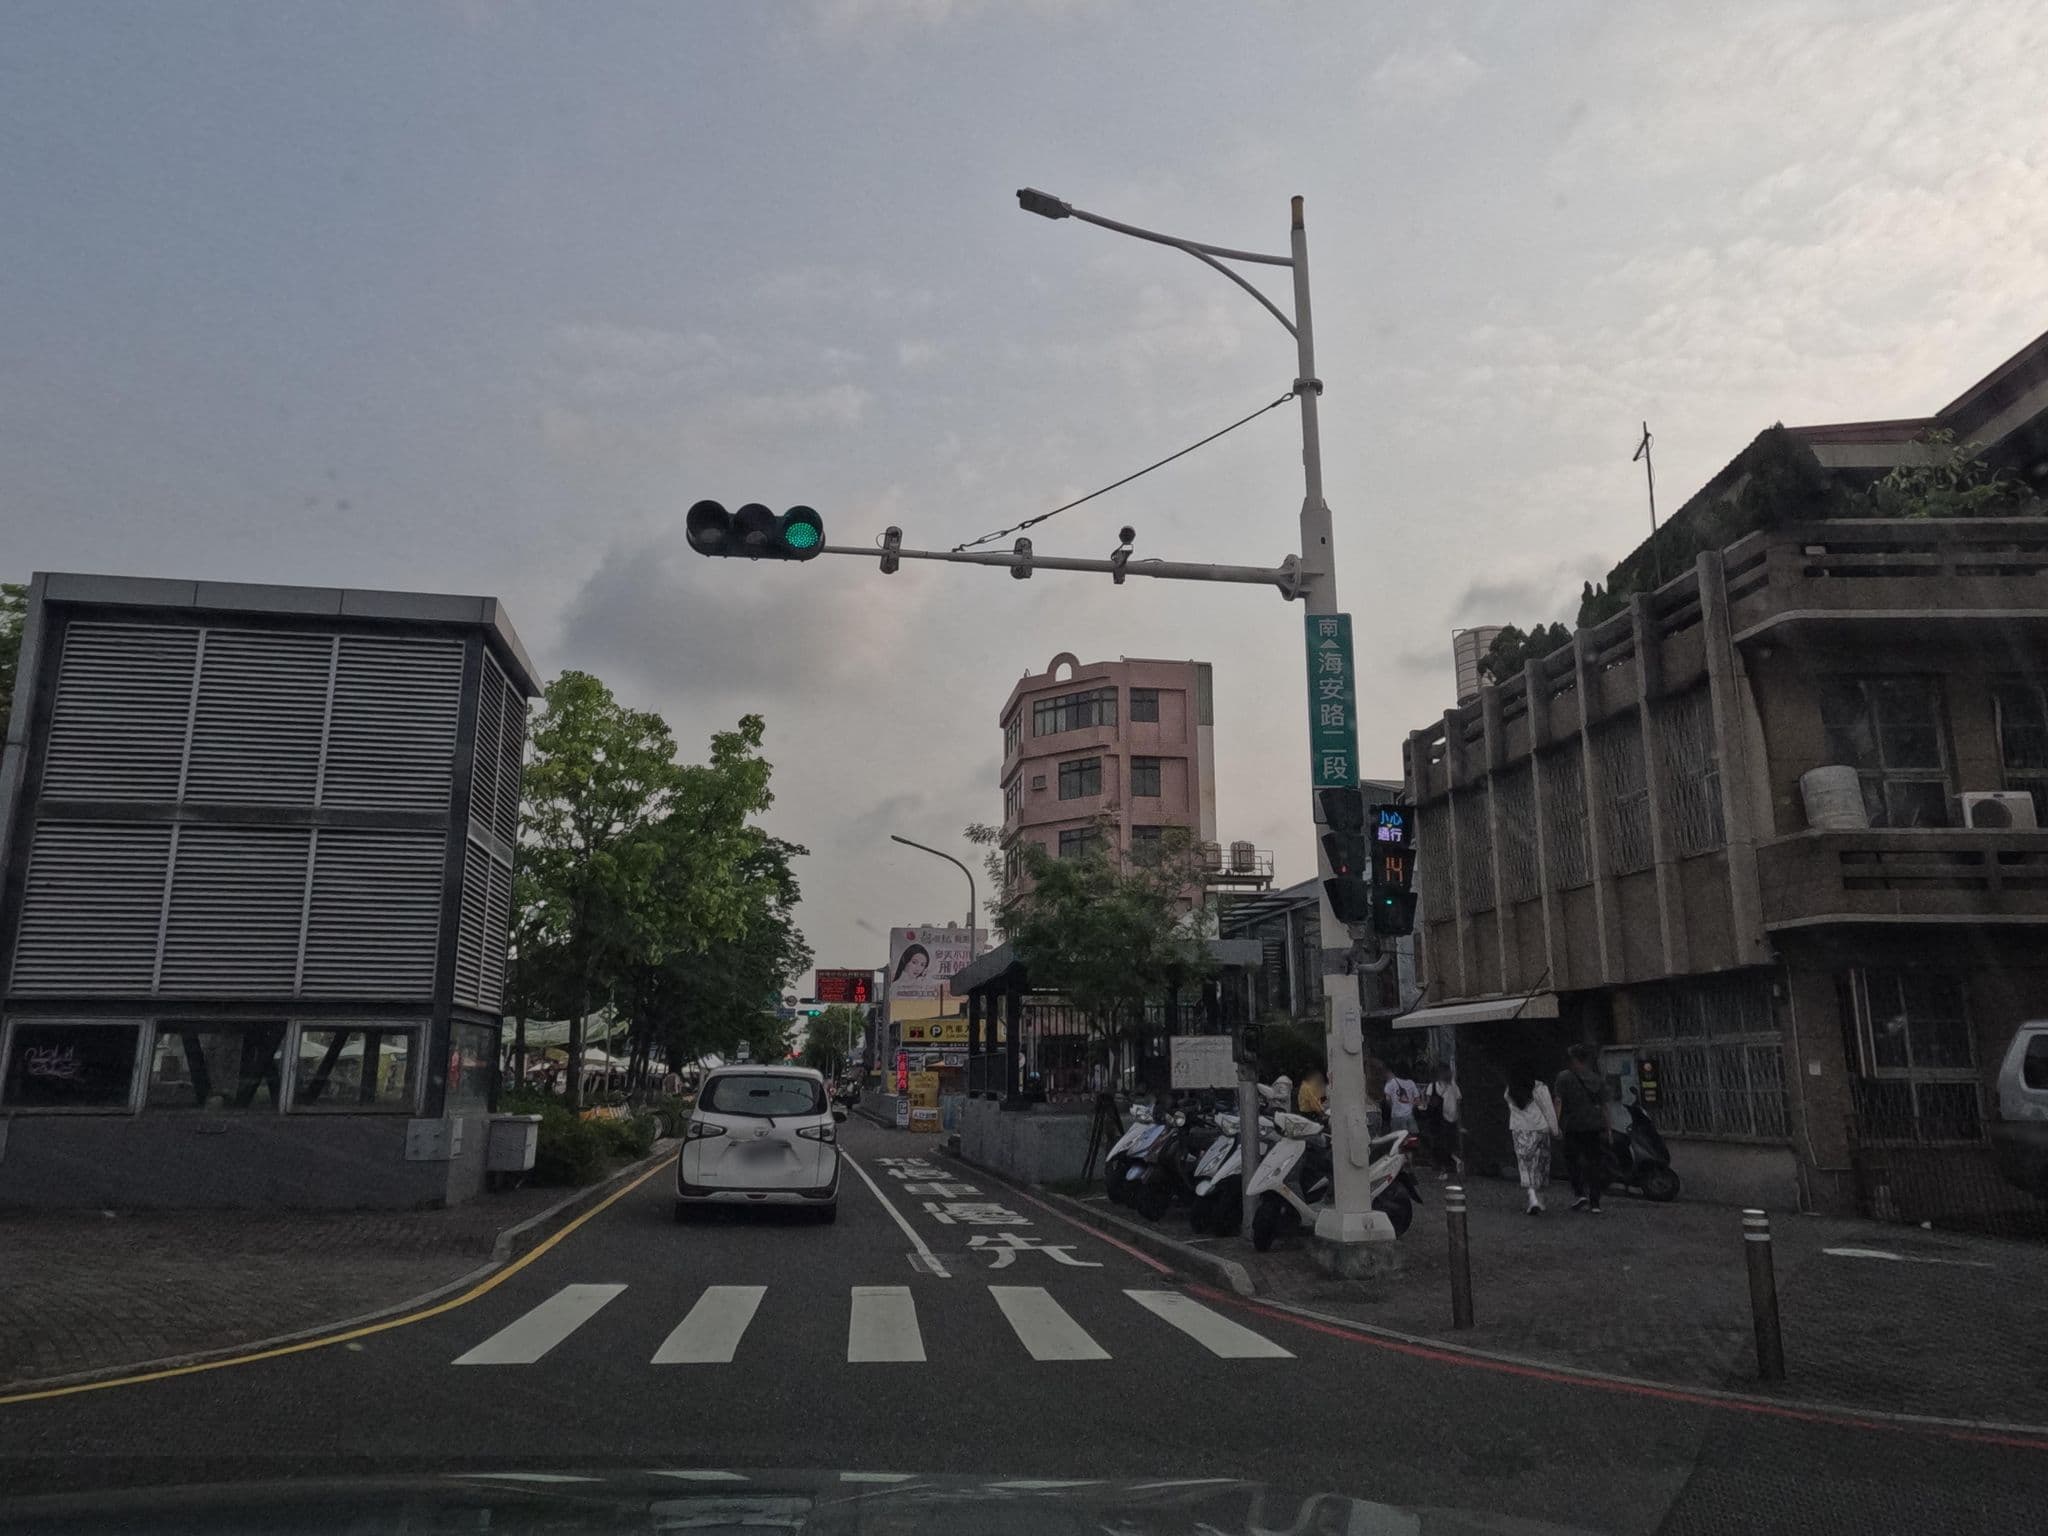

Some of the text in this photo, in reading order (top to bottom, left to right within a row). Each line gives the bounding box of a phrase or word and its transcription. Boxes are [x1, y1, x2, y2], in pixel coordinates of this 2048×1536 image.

[1318, 619, 1339, 637] 南
[1318, 651, 1349, 780] 海安路二段
[1379, 809, 1404, 825] 小心
[1385, 857, 1404, 882] 14
